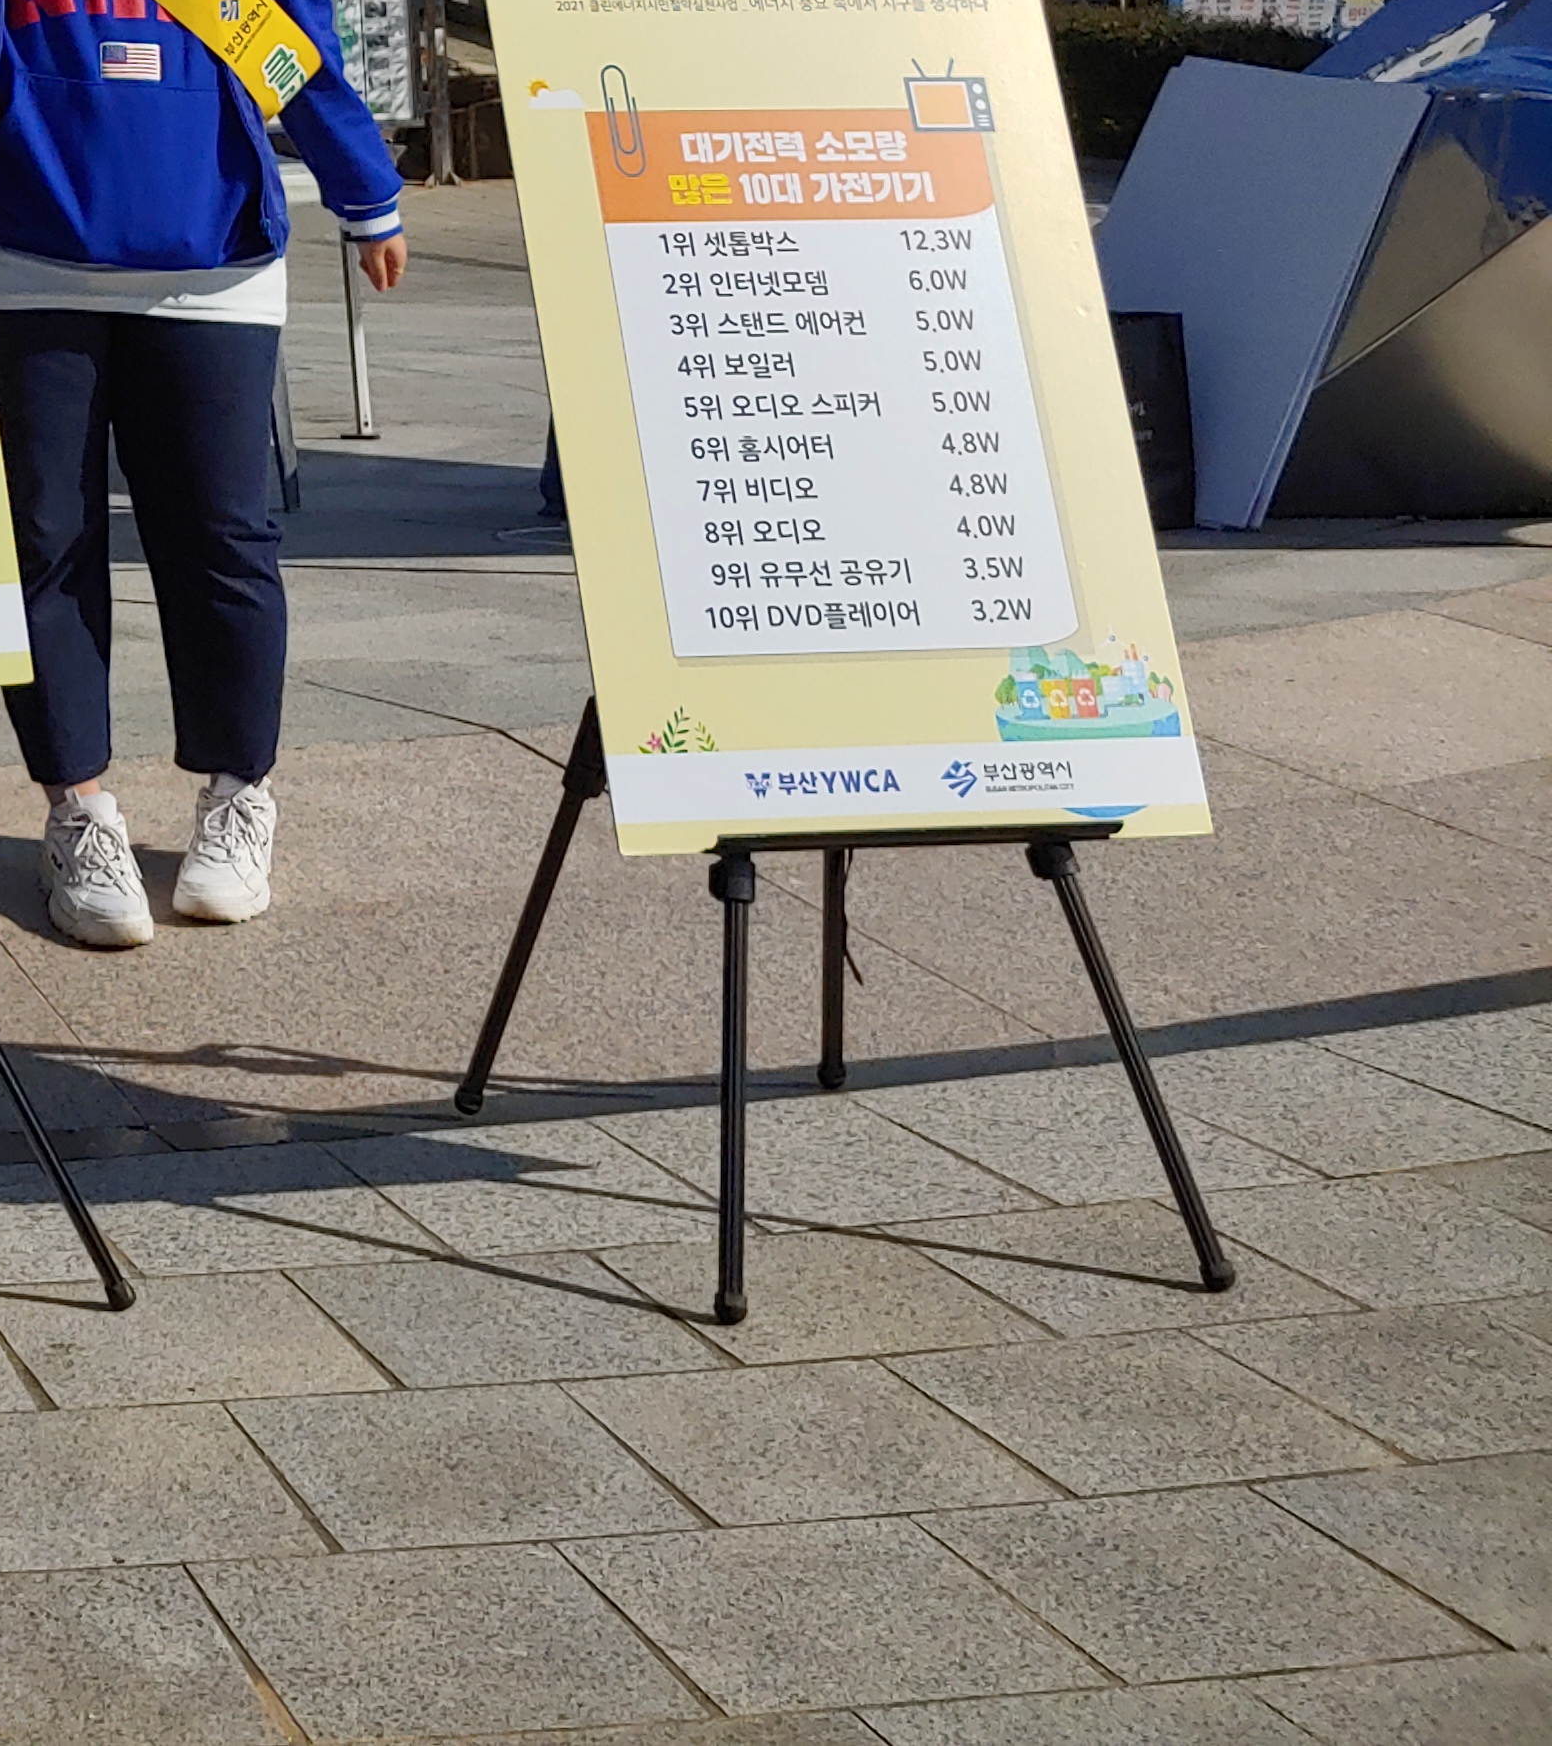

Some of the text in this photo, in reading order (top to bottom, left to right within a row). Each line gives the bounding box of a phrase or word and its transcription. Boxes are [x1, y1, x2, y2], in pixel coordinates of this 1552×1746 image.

[681, 131, 907, 162] 대기전력 소모량
[668, 172, 935, 205] 많은 10대 가전기기
[659, 230, 971, 256] 1위 셋톱박스 12.3W
[663, 272, 701, 297] 2위
[909, 270, 966, 292] 6.0W
[670, 310, 973, 337] 3위 스탠드 에어컨 5.0W
[678, 350, 980, 378] 4위 보일러 5.0W
[983, 761, 1074, 781] 부산광역시
